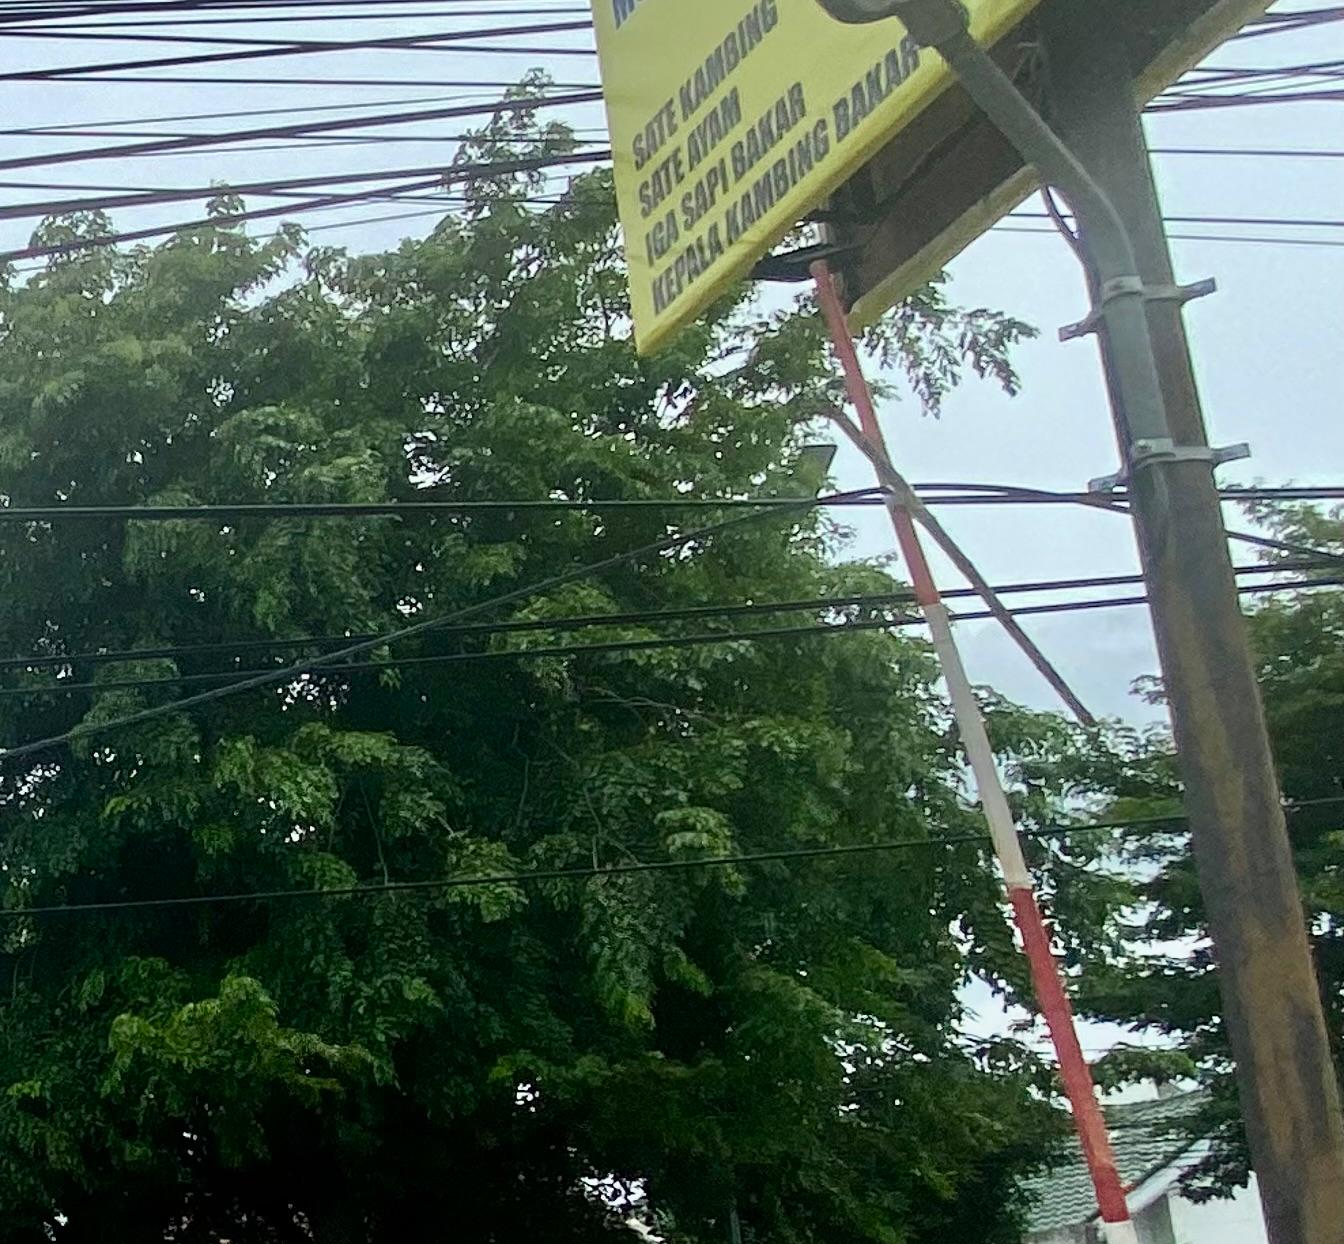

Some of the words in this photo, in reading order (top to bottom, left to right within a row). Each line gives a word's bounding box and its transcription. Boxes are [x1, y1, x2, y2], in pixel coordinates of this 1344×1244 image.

[632, 97, 679, 172] SATE
[679, 0, 779, 122] KAMBING
[638, 146, 686, 219] SATE
[686, 86, 742, 172] AYAM
[645, 209, 680, 268] IGA
[680, 158, 730, 232] SAPI
[730, 81, 807, 183] BAKAR
[651, 222, 724, 316] KEPALA
[724, 118, 830, 248] KAMBING
[832, 35, 921, 143] BAKAR
